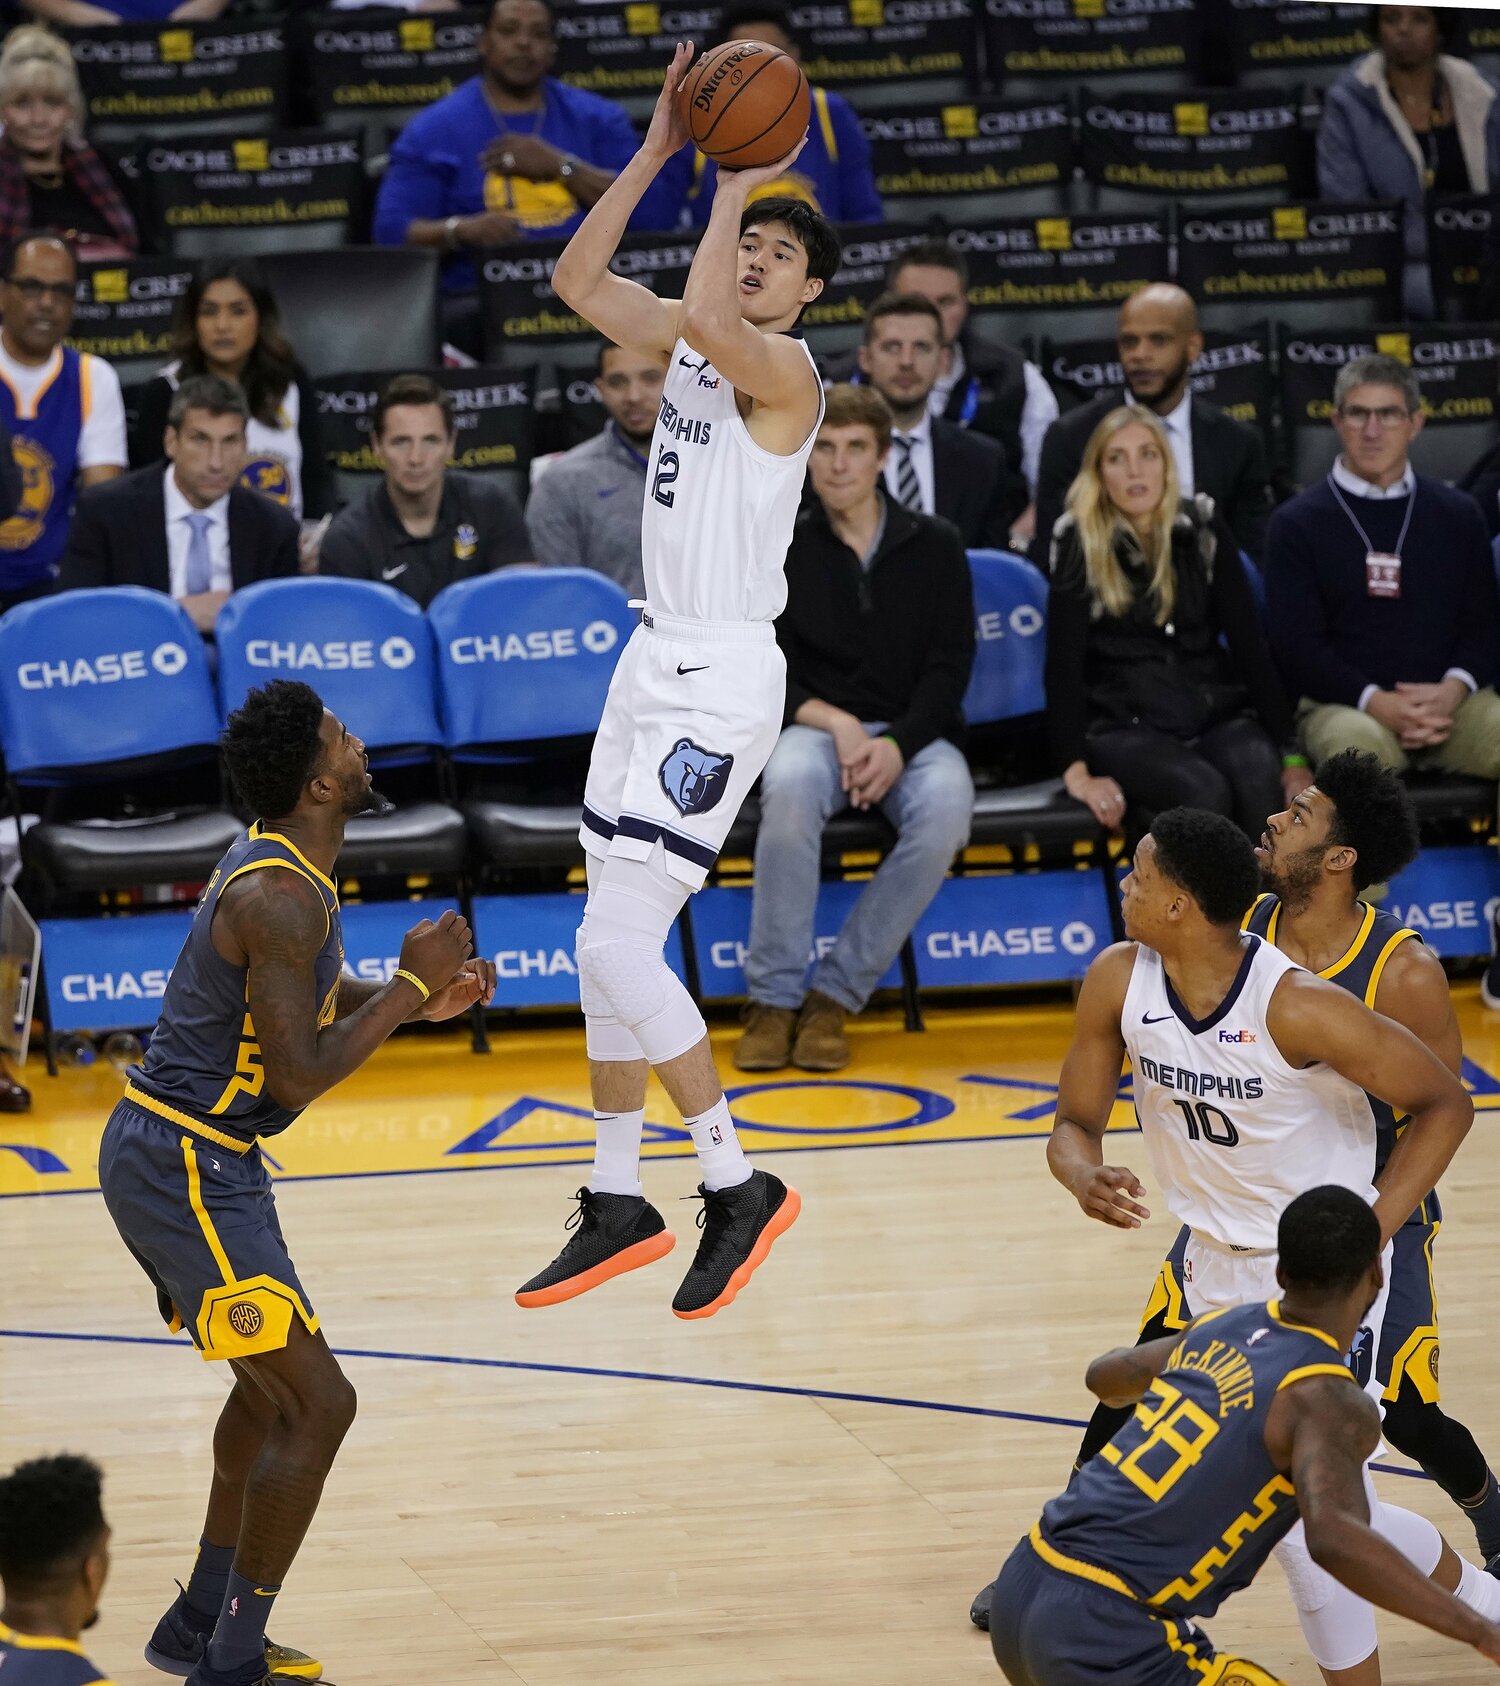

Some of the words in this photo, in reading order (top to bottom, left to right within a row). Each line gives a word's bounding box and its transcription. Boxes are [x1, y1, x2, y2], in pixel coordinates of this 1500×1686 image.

[246, 640, 374, 670] CHASE
[450, 630, 578, 664] CHASE
[18, 650, 148, 690] CHASE
[1392, 901, 1479, 930] ASE
[927, 927, 1056, 959] CHASE
[495, 949, 578, 978] CHA
[1219, 1030, 1256, 1043] FedEx
[1139, 1056, 1263, 1100] MEMPHIS
[1173, 1099, 1239, 1147] 10
[1167, 1339, 1254, 1418] McKINNIE
[1100, 1377, 1220, 1502] 28
